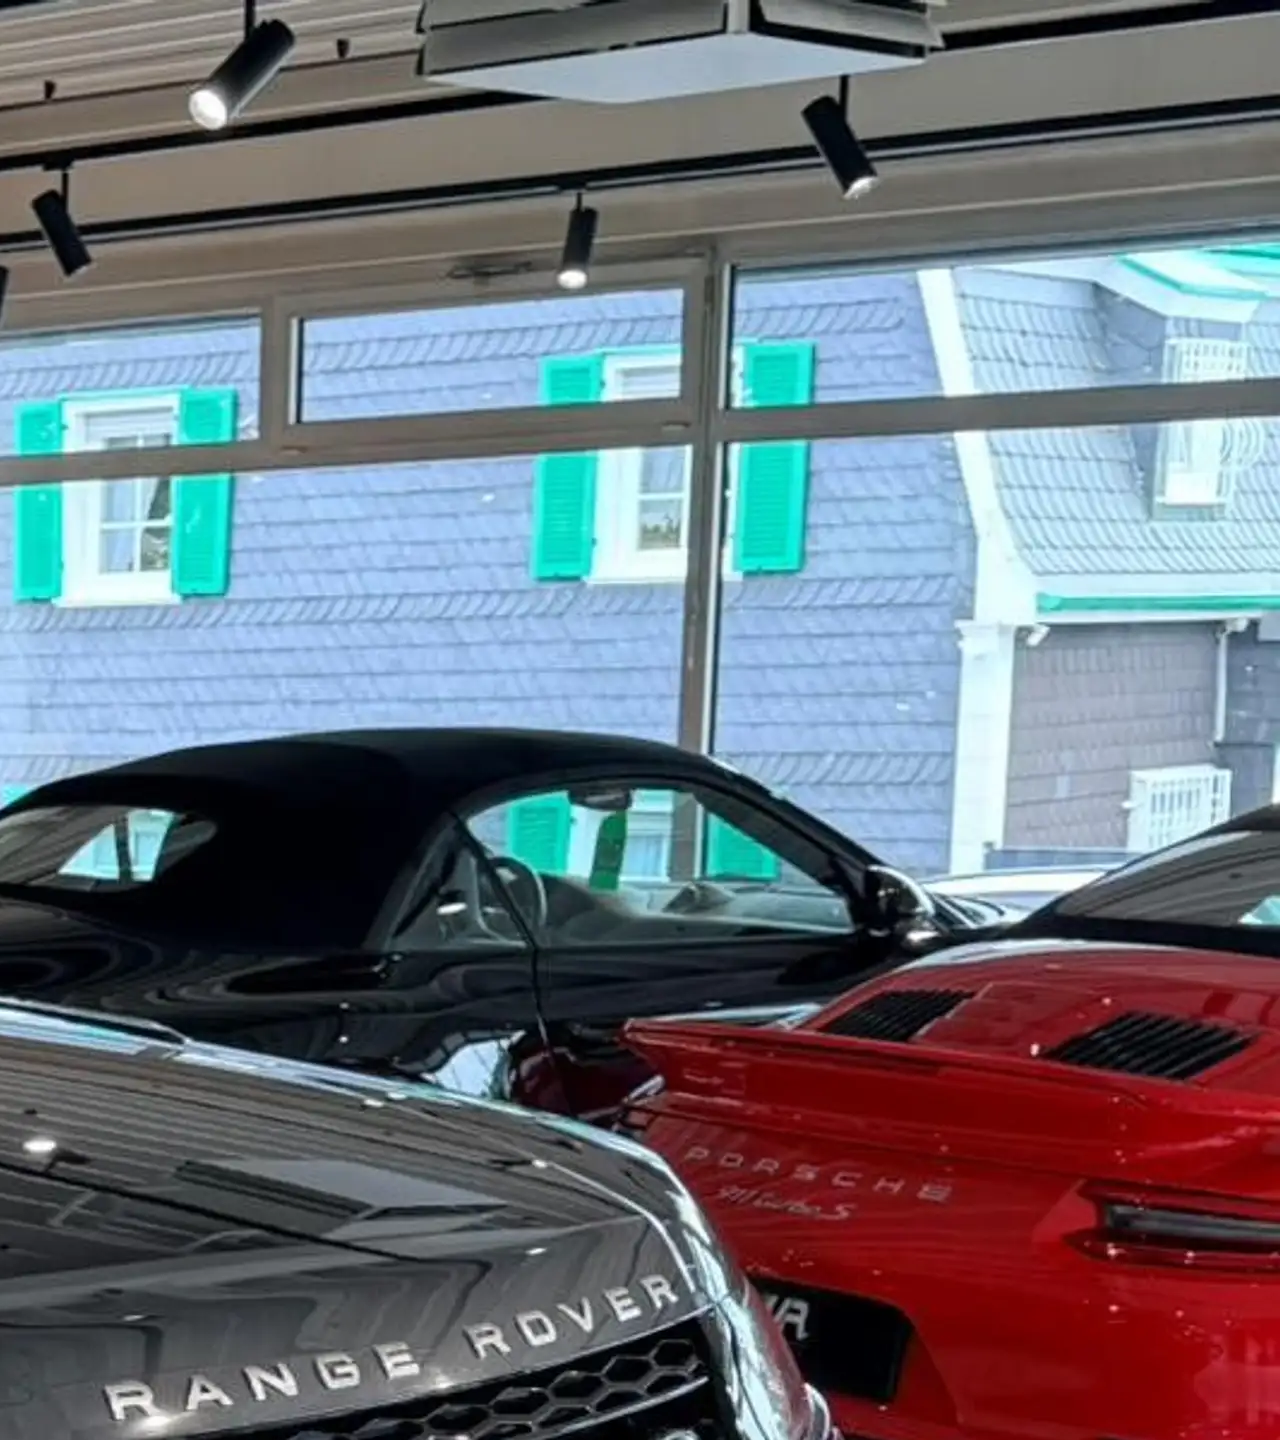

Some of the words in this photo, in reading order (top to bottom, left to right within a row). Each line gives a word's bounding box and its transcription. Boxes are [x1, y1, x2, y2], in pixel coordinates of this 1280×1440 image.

[684, 1145, 953, 1203] PORSCHE
[104, 1340, 421, 1421] RANGE
[462, 1273, 679, 1360] ROVER
